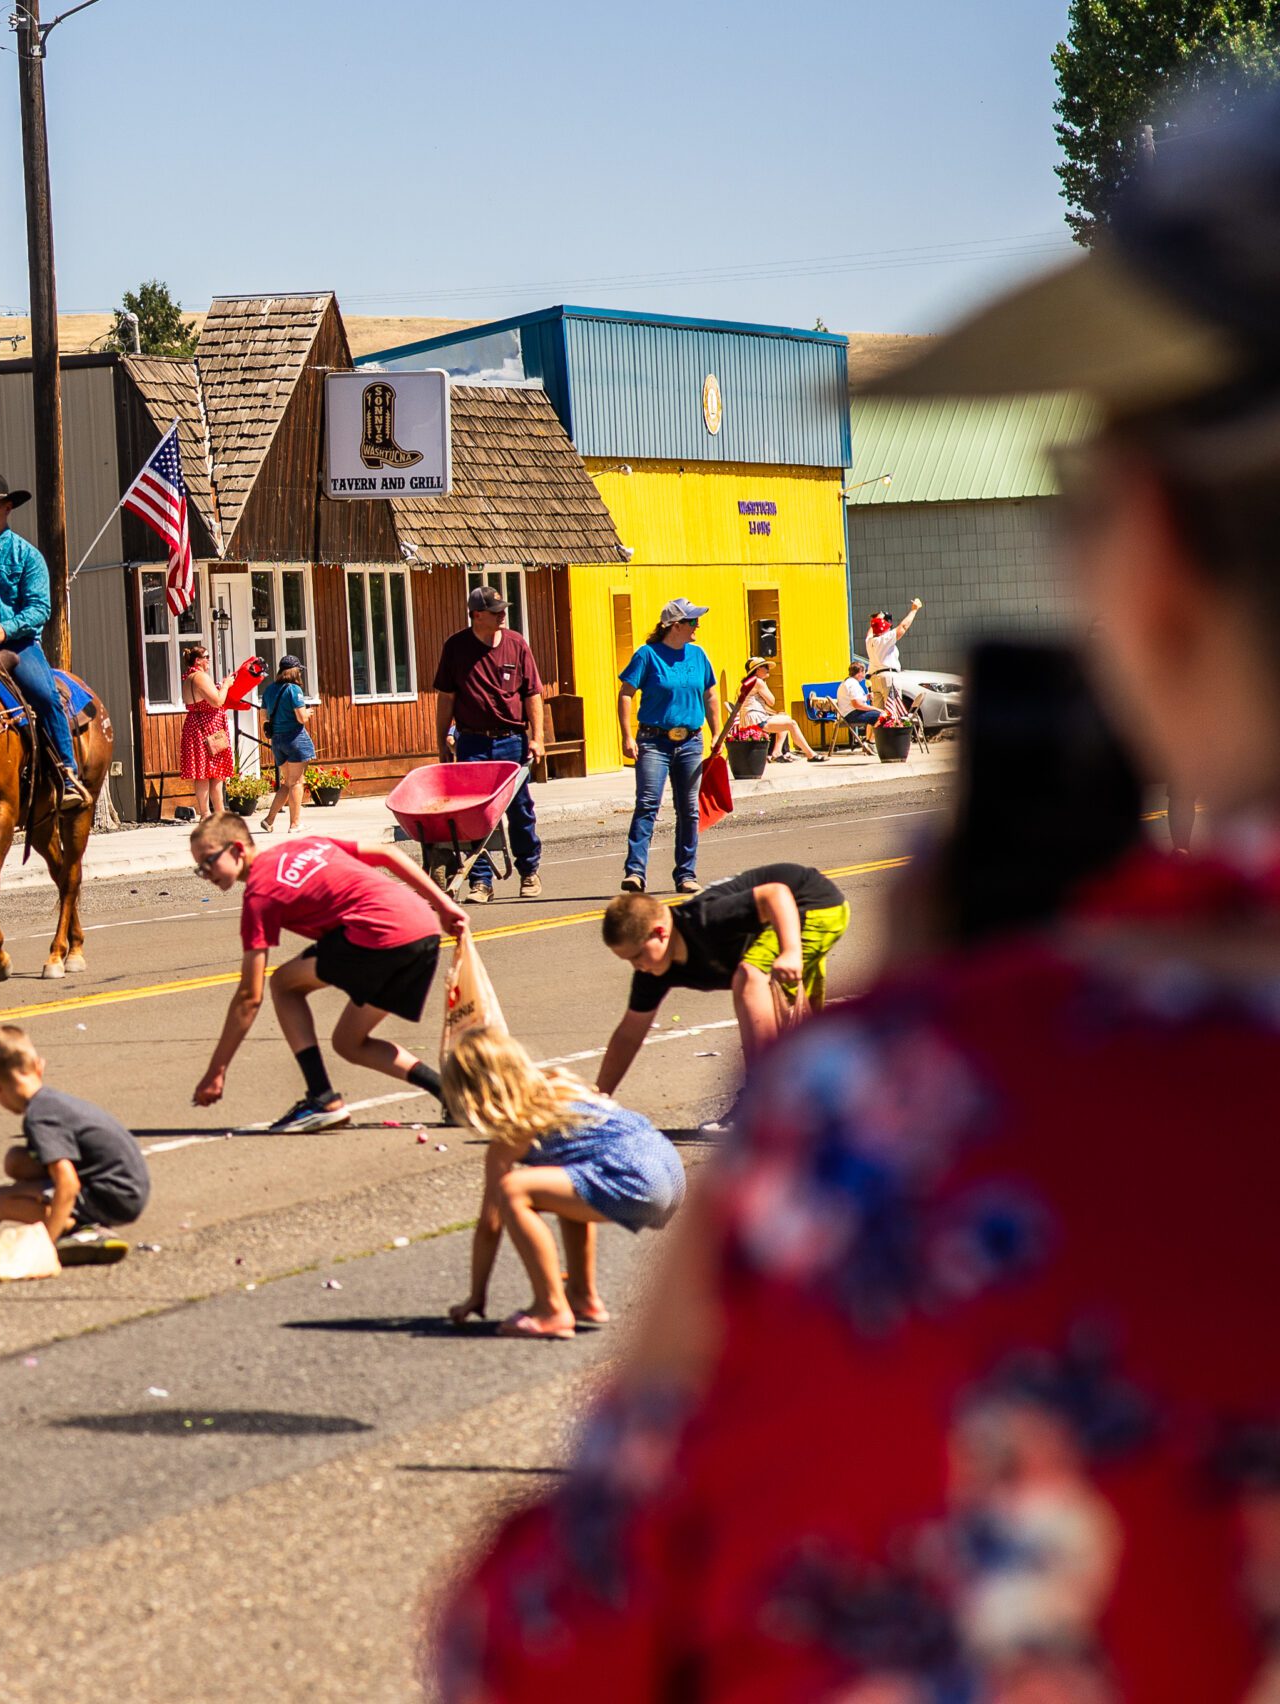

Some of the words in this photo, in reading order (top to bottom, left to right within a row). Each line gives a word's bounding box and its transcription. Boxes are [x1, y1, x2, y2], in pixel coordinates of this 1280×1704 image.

[374, 386, 383, 444] SONNYS
[363, 444, 412, 463] WASHTUCNA
[331, 478, 377, 491] TAVERN
[380, 476, 406, 490] AND
[409, 476, 443, 490] GRILL
